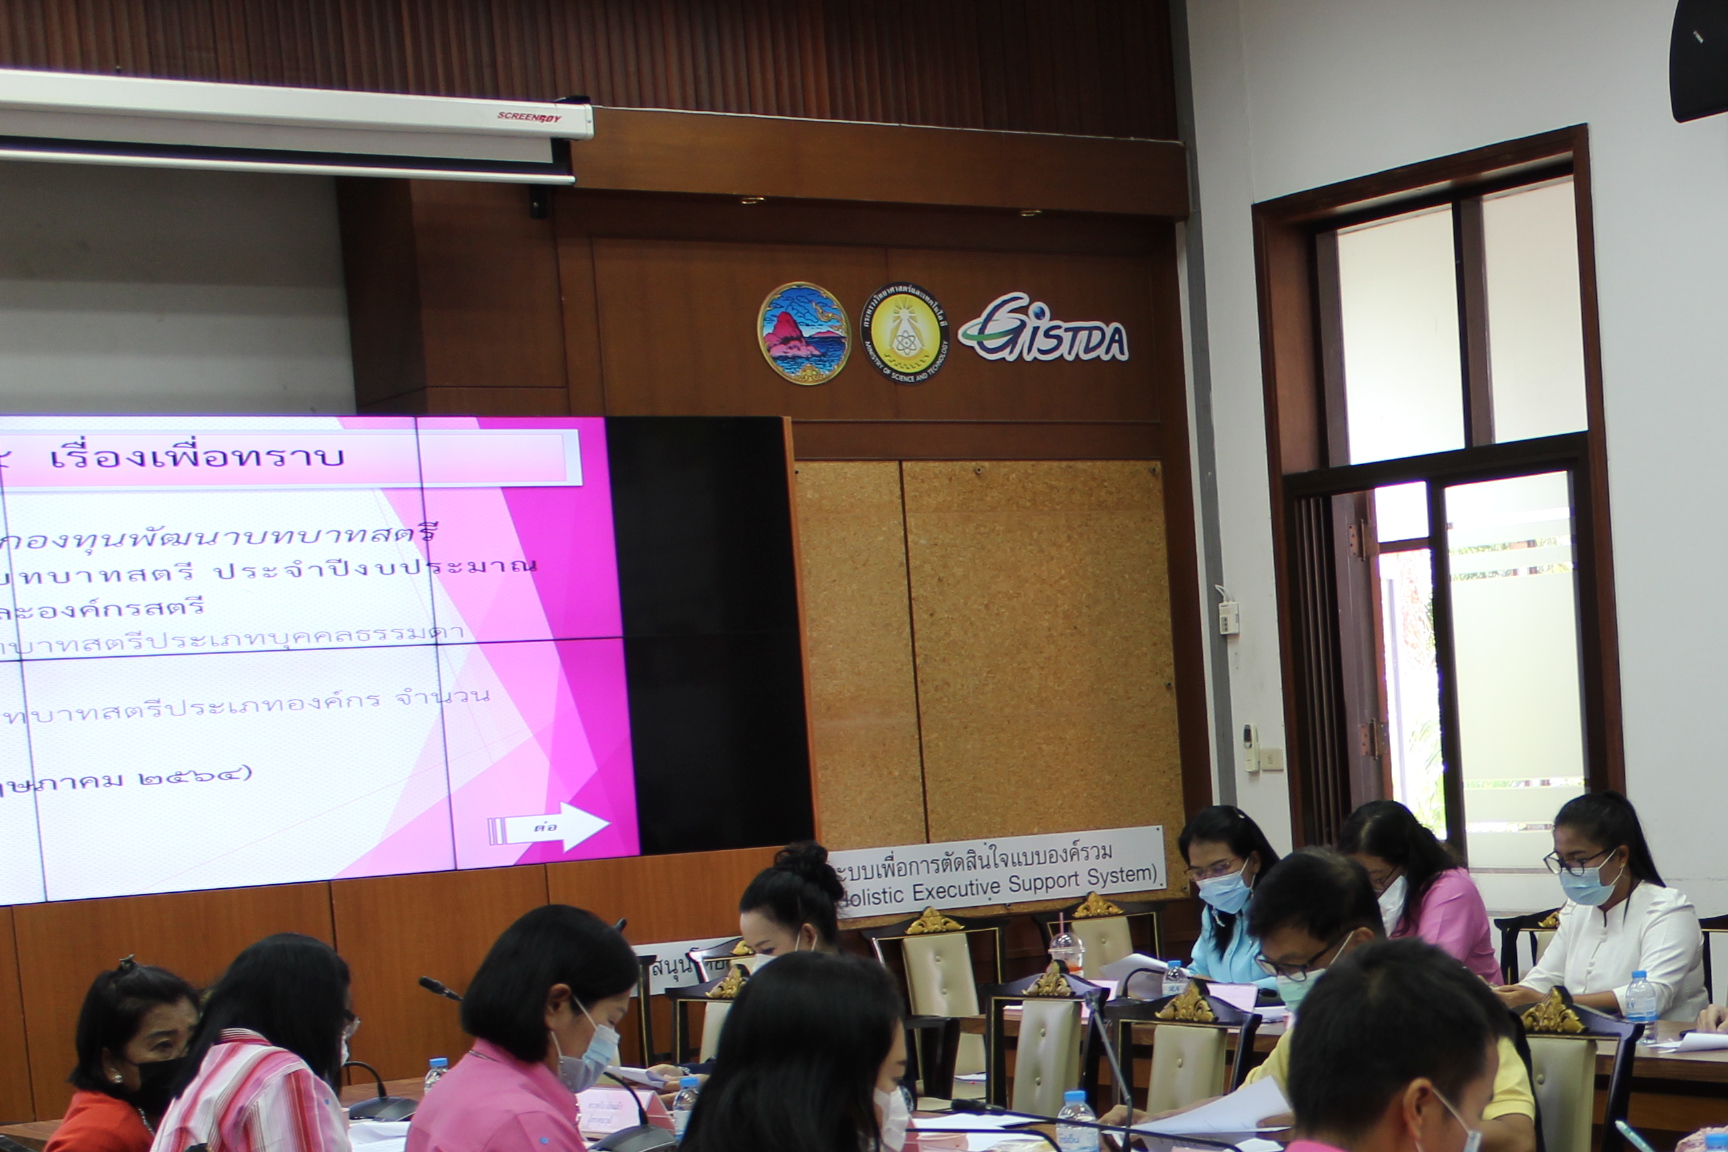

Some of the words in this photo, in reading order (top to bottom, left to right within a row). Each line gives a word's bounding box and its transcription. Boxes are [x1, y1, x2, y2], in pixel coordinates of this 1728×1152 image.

[865, 341, 884, 368] MINISTRY
[883, 367, 891, 375] OF
[891, 372, 915, 382] SCIENCE
[916, 373, 928, 381] AND
[927, 340, 948, 375] TECHNOLOGY
[50, 435, 345, 469] เรื่องเพื่อทราบ
[0, 521, 438, 556] กองทุนพัฒนาบทบาทสตรี
[213, 556, 538, 581] ประจำปีงบประมาณ
[0, 626, 464, 655] บาทสตรีประเภทบุคคลธรรมดา
[3, 688, 380, 724] ทบาทสตรีประเภทองค์กร
[395, 686, 491, 707] จำนวน
[0, 772, 124, 797] ษภาคม
[139, 765, 252, 786] ๒๕๖๔)
[533, 820, 557, 833] ต่อ
[836, 839, 1113, 882] ะบบเพื่อการตัดสินใจแบบองค์รวม
[843, 886, 904, 908] olistic
[912, 879, 1001, 901] Executive
[1008, 870, 1080, 895] Support
[1087, 863, 1157, 890] System)
